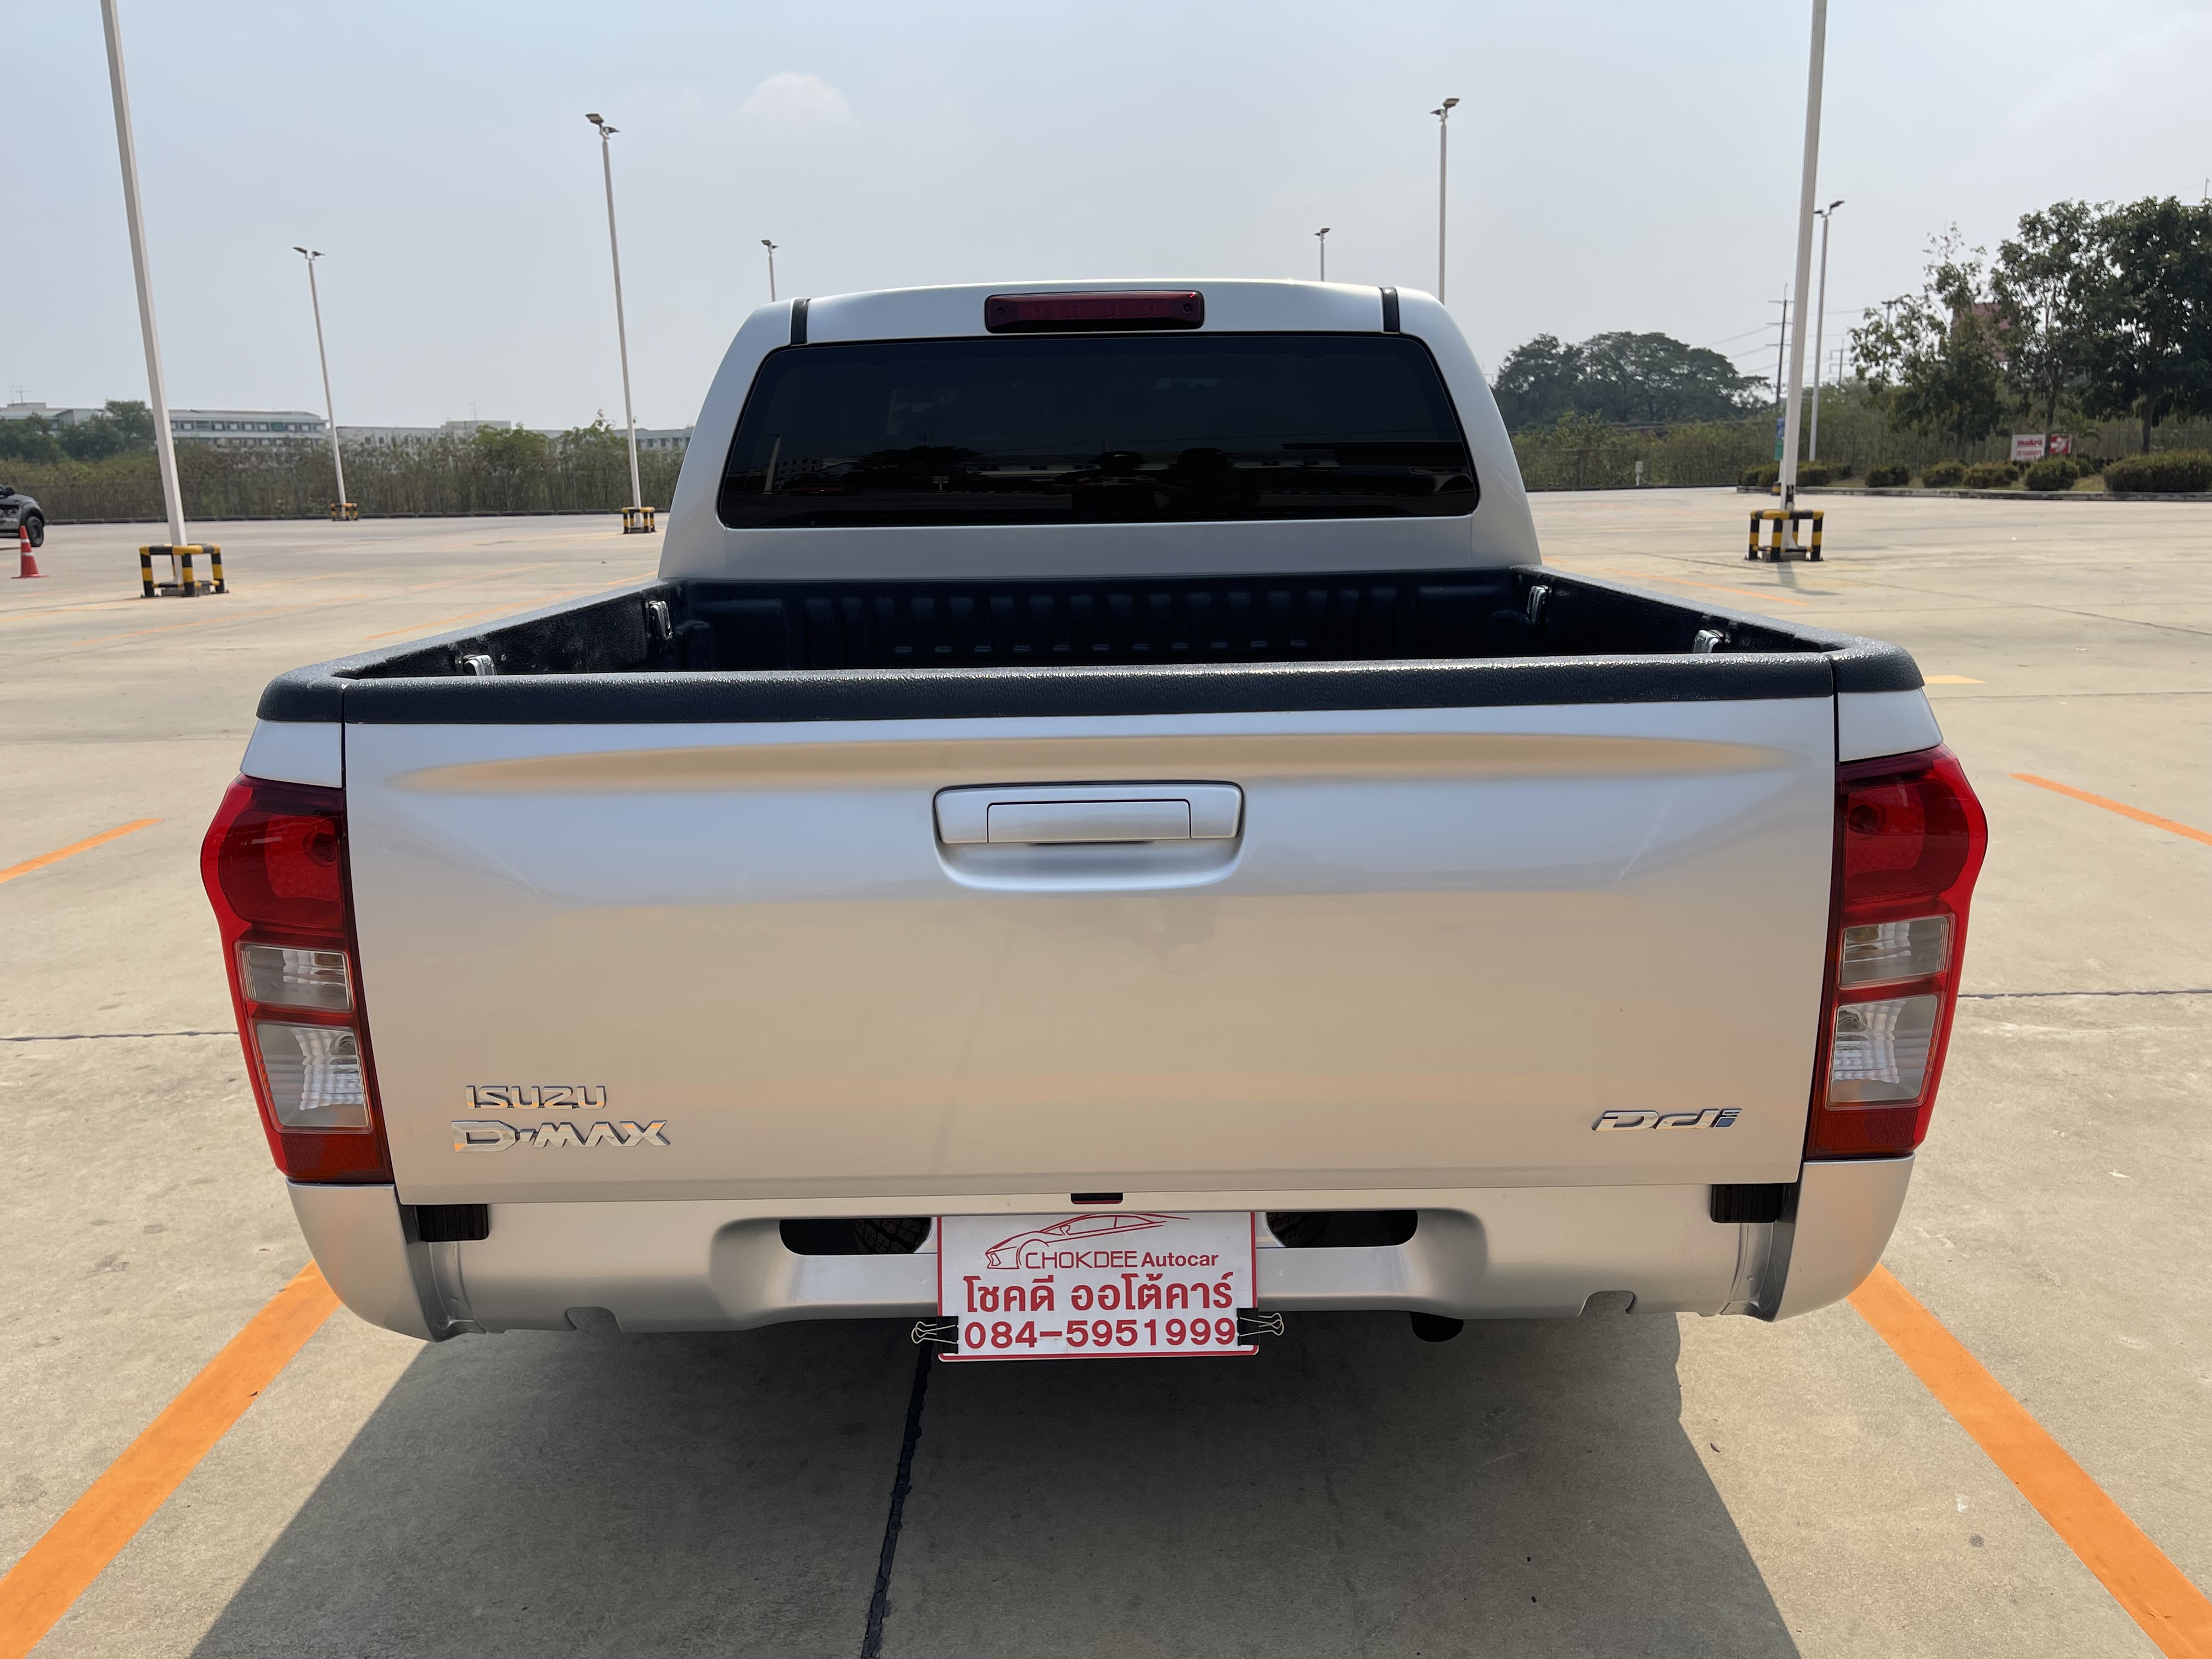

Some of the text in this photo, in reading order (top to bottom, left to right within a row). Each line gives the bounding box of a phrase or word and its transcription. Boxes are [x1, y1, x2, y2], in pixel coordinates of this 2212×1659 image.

[465, 1085, 607, 1109] ISUZU
[450, 1120, 670, 1152] D-MAX
[1025, 1250, 1218, 1269] CHOKDEE Autocar
[963, 1271, 1233, 1313] โชคดี ออโต้คาร์
[964, 1317, 1235, 1349] 084-5951999
